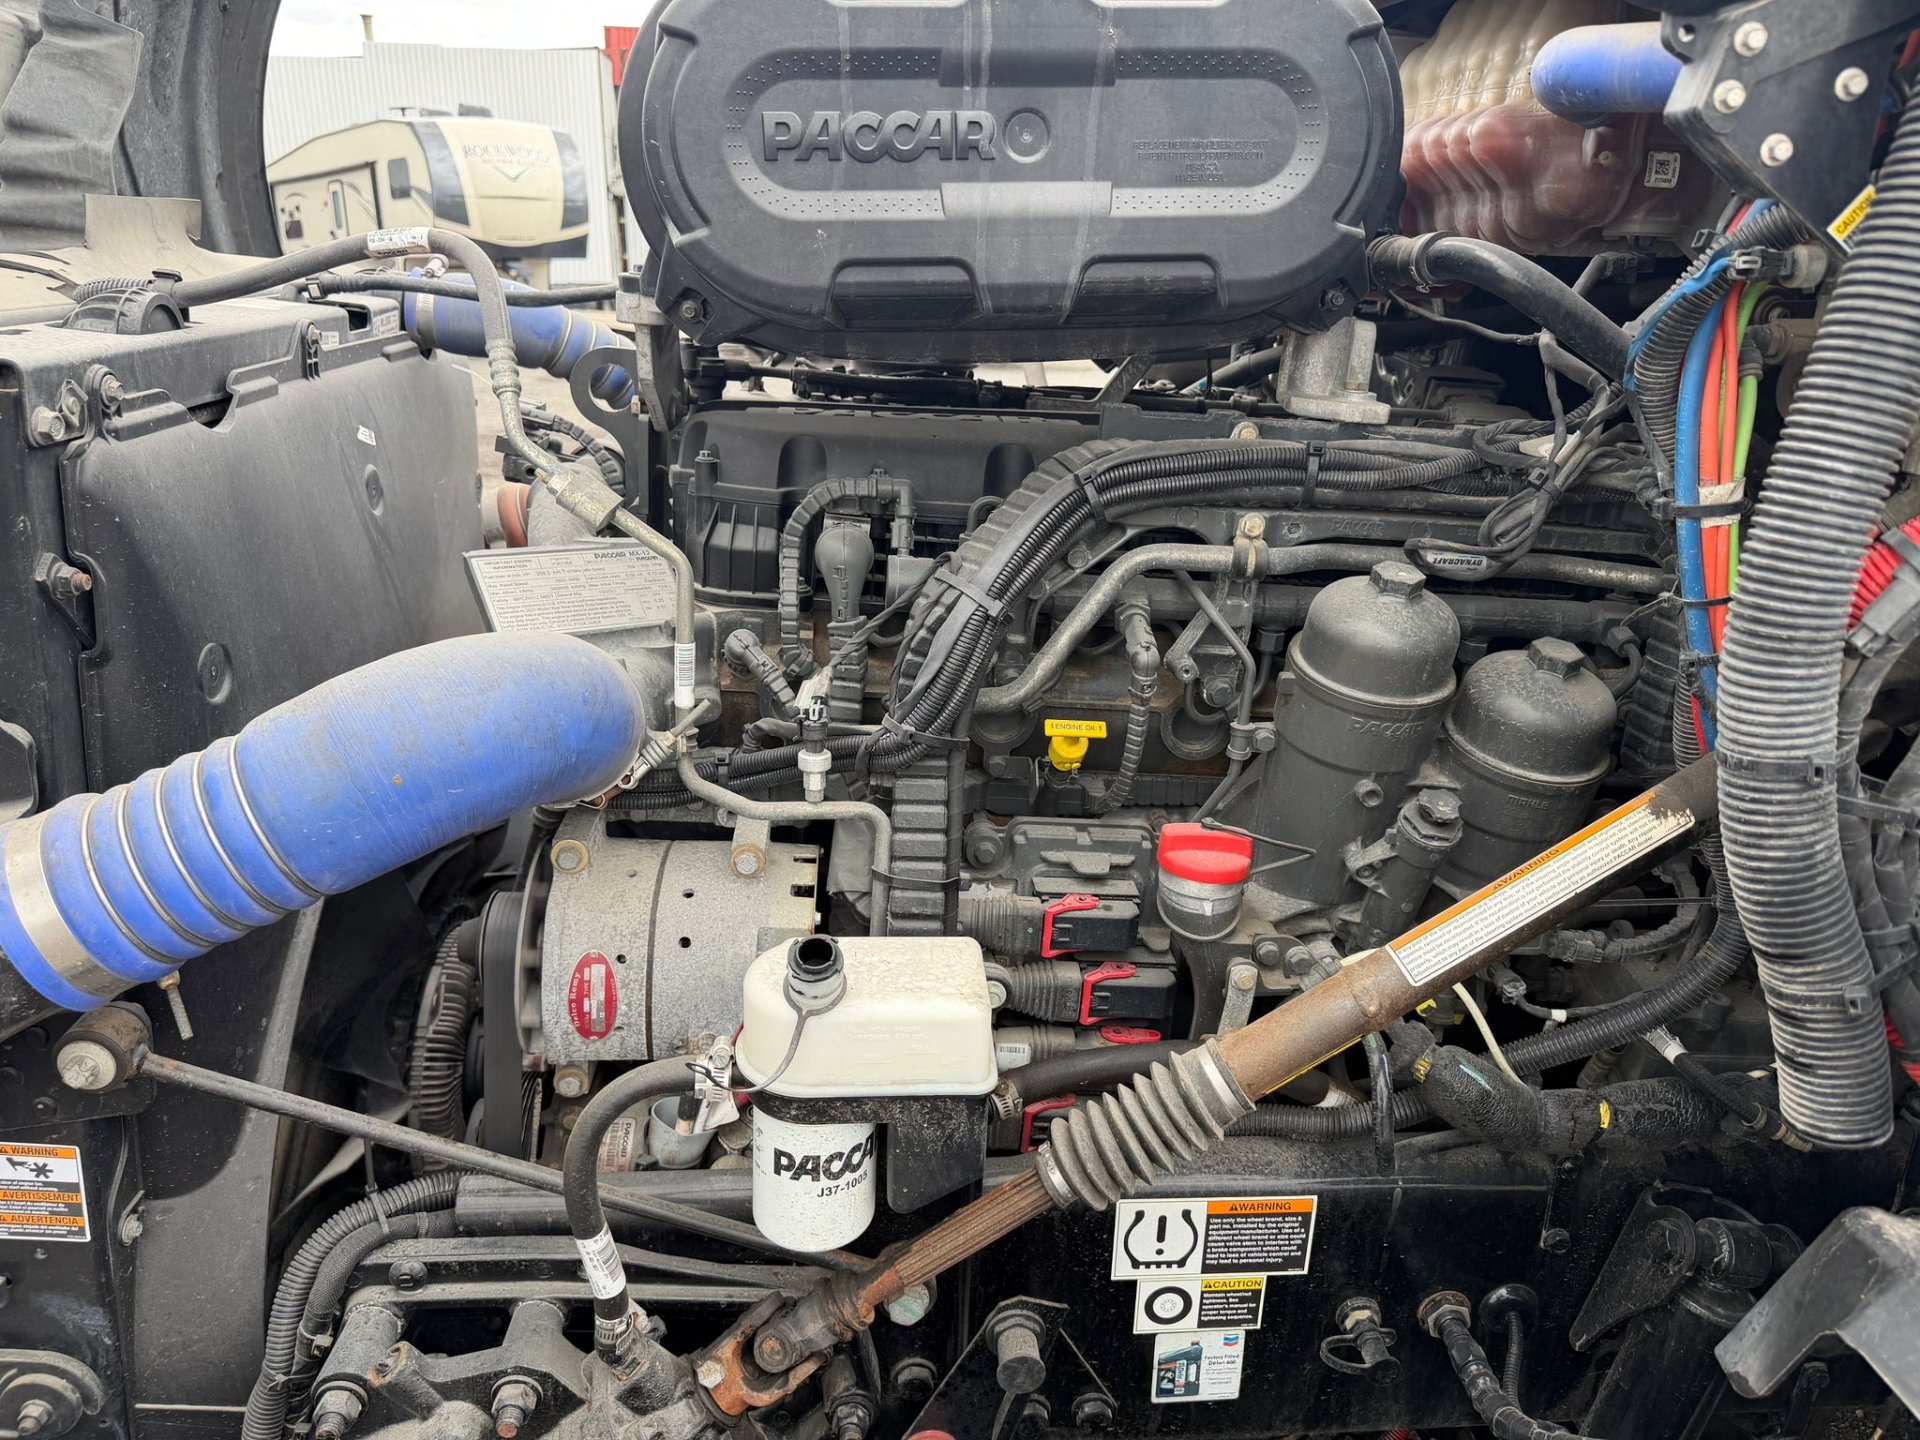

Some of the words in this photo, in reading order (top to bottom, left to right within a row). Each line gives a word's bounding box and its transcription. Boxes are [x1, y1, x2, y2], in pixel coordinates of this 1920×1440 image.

[761, 110, 996, 163] PACCAR
[1432, 558, 1483, 566] DYNACRAFT
[1500, 847, 1559, 884] WARNING
[570, 972, 581, 1000] Remy
[621, 1122, 632, 1158] PACCAR
[12, 1146, 58, 1156] WARNING
[774, 1129, 875, 1182] PACCA
[816, 1169, 868, 1198] J37-1005
[3, 1192, 80, 1202] AVERTISSEMENT
[1238, 1202, 1291, 1211] WARNING
[12, 1215, 78, 1225] ADVERTENCIA
[1213, 1280, 1261, 1288] CAUTION
